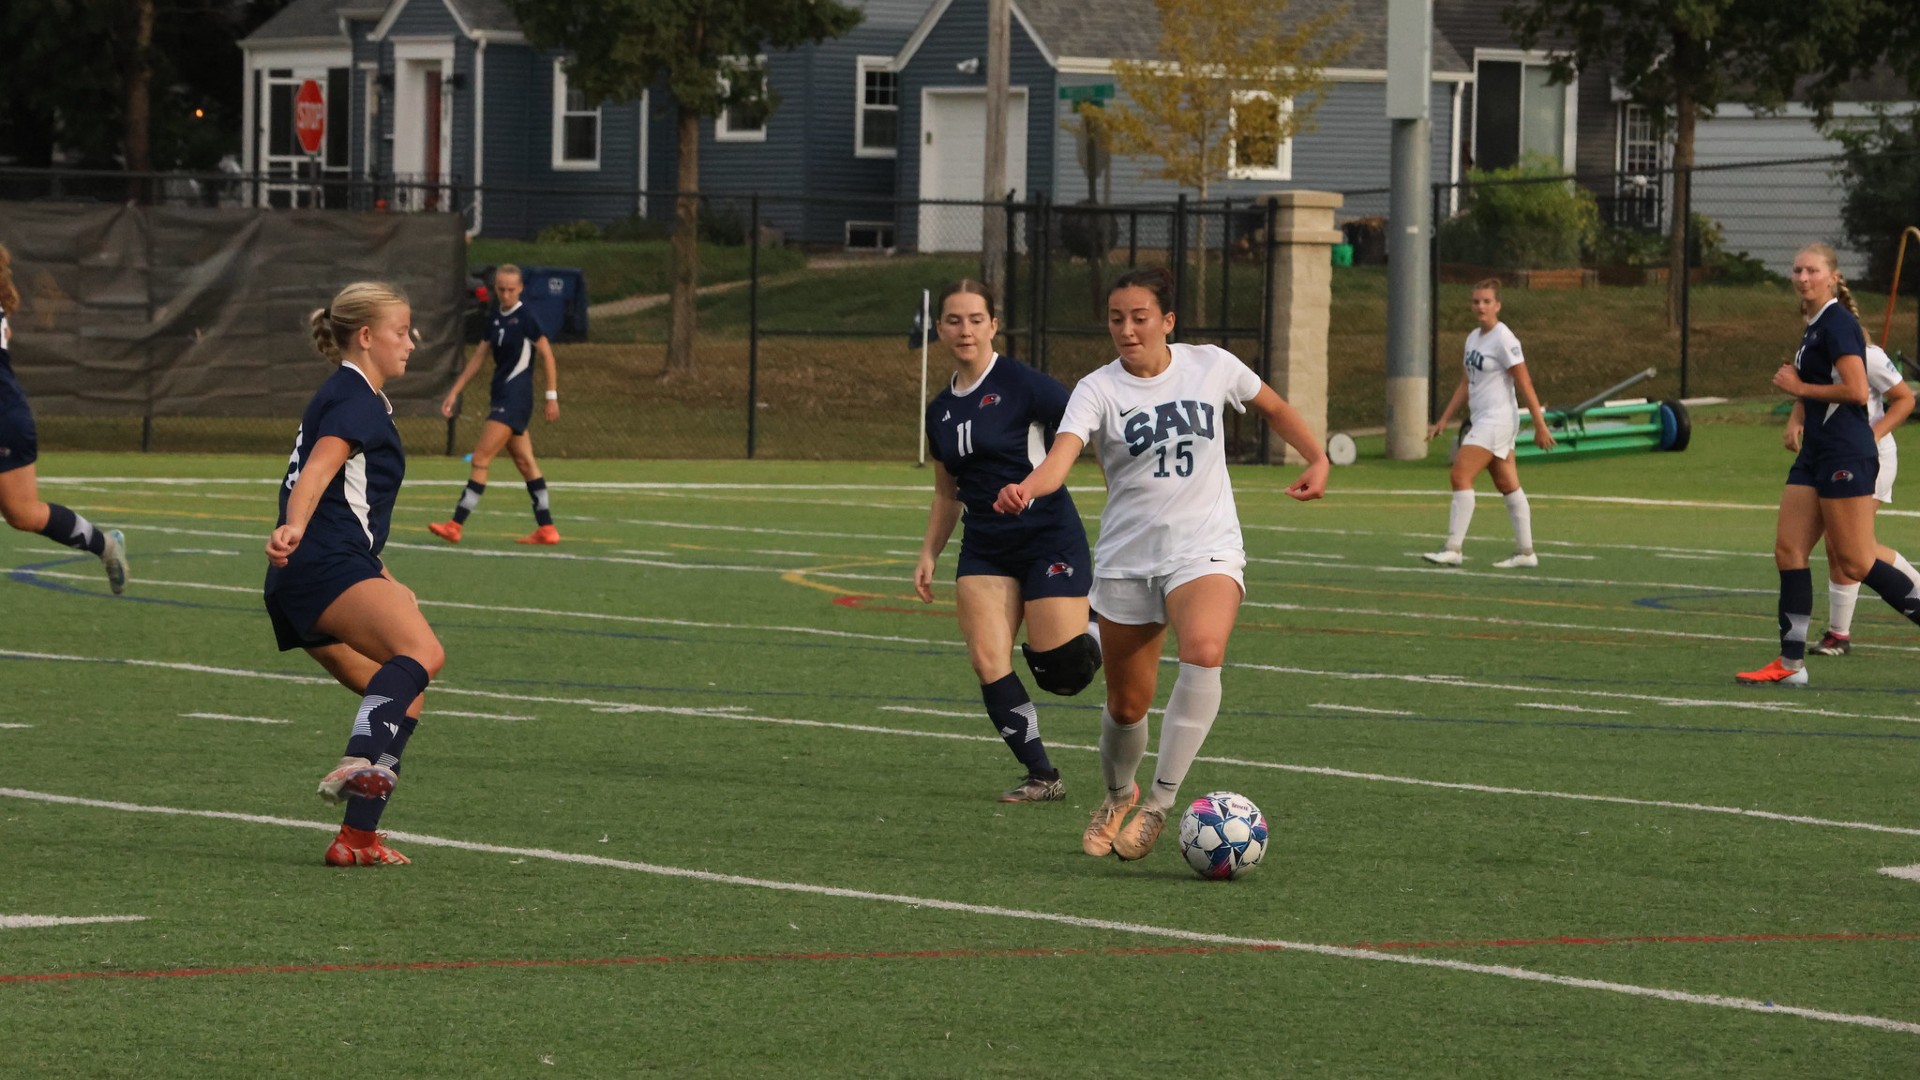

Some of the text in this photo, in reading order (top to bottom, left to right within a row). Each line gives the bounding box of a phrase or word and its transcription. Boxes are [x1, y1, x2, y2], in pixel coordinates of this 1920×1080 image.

[297, 102, 324, 129] STOP
[956, 419, 974, 457] 11
[1124, 400, 1215, 457] SAU
[1153, 440, 1194, 478] 15
